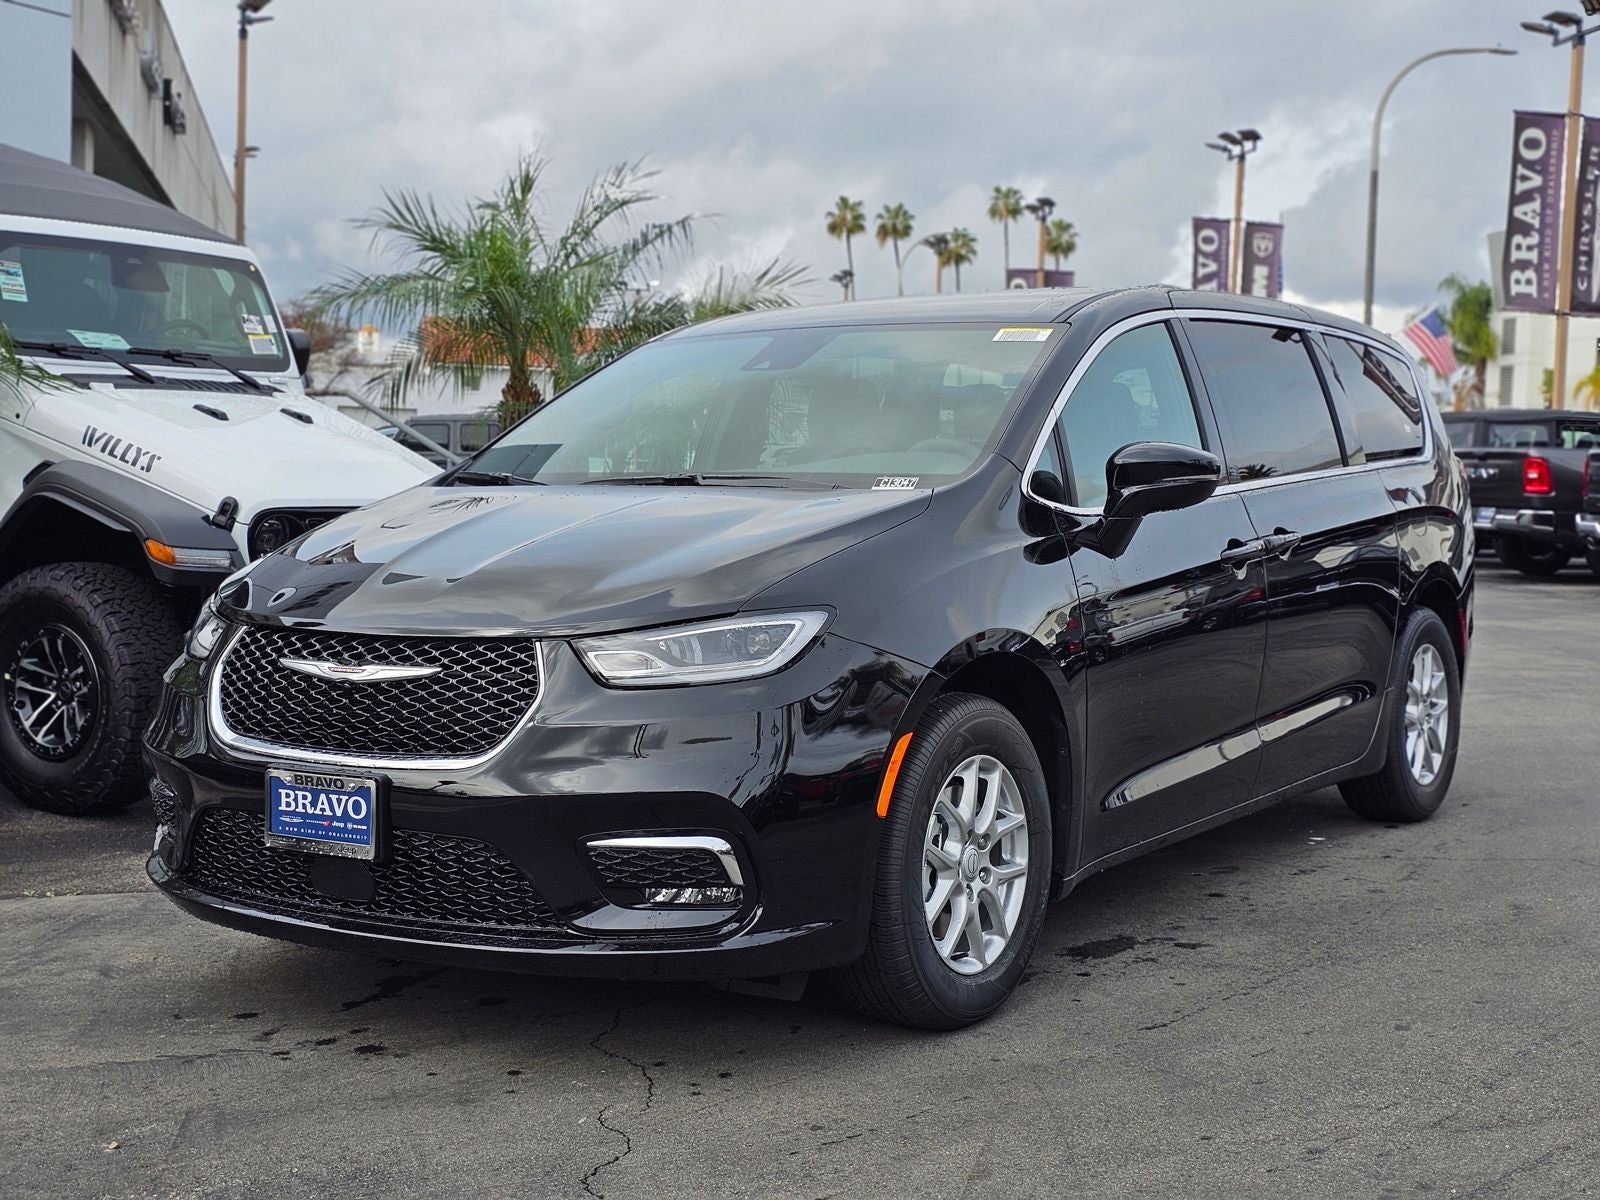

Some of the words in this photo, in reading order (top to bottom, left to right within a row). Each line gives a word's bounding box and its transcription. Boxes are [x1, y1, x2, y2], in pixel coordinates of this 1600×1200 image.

[1509, 127, 1547, 298] BRAVO
[1577, 145, 1600, 290] CHRYSLER
[82, 425, 162, 473] WILLYS
[294, 774, 345, 790] BRAVO
[278, 788, 367, 820] BRAVO
[332, 820, 345, 828] Jeep
